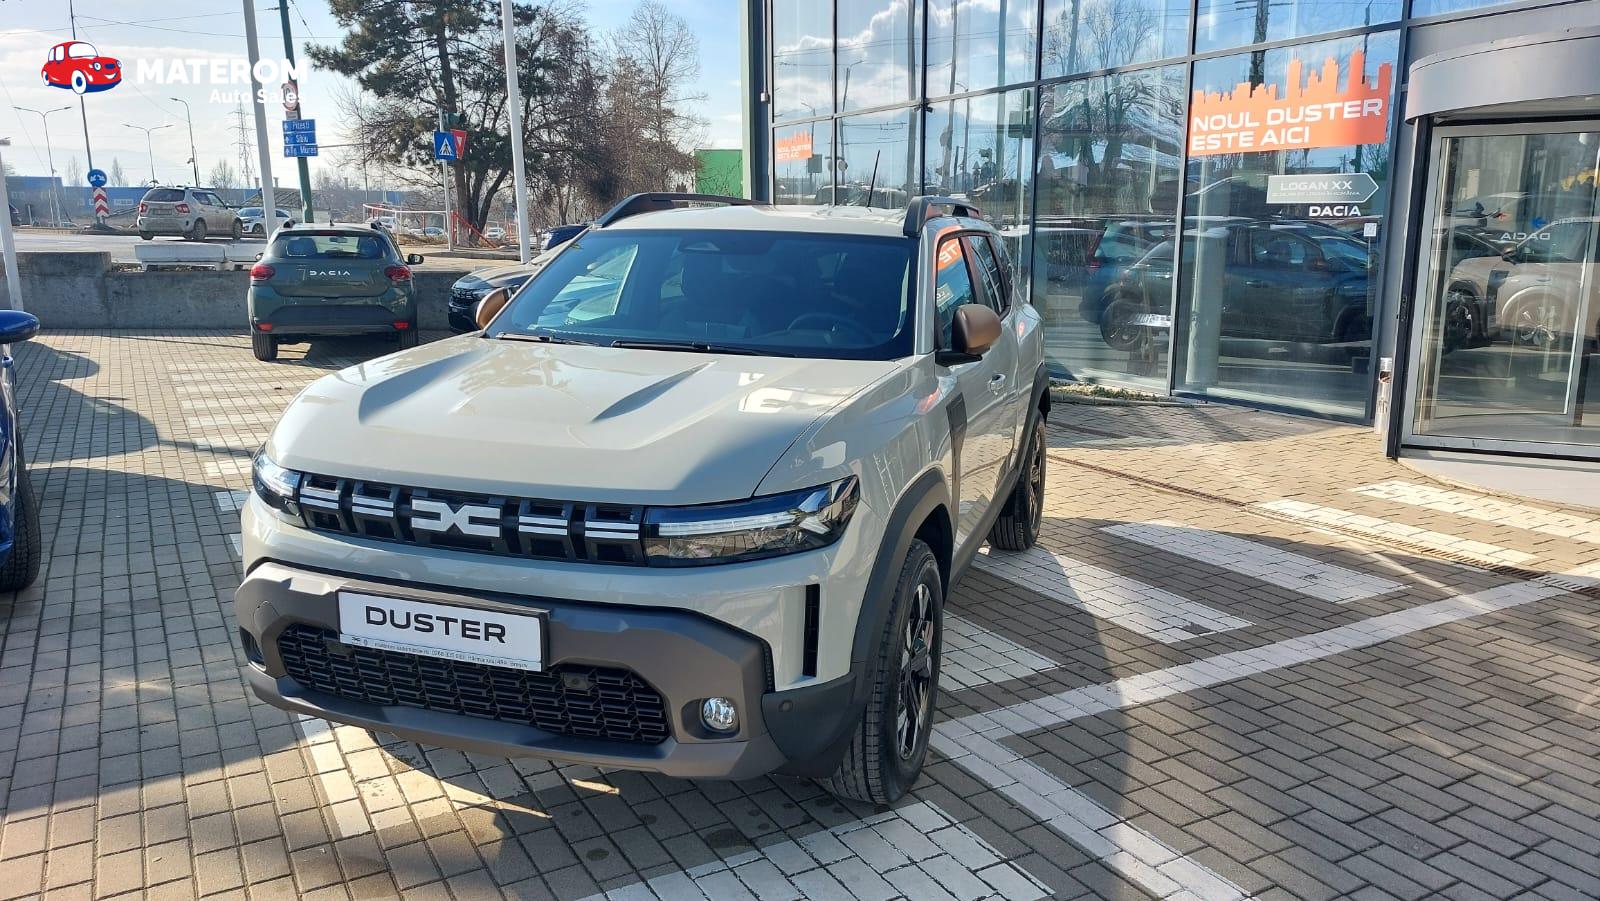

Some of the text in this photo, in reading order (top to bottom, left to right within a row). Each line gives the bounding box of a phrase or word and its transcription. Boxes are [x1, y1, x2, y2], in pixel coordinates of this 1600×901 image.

[1192, 98, 1383, 132] NOUL DUSTER
[1191, 126, 1310, 151] ESTE AICI
[1280, 181, 1329, 191] LOGAN
[1308, 205, 1362, 217] DACIA
[365, 605, 506, 644] DUSTER
